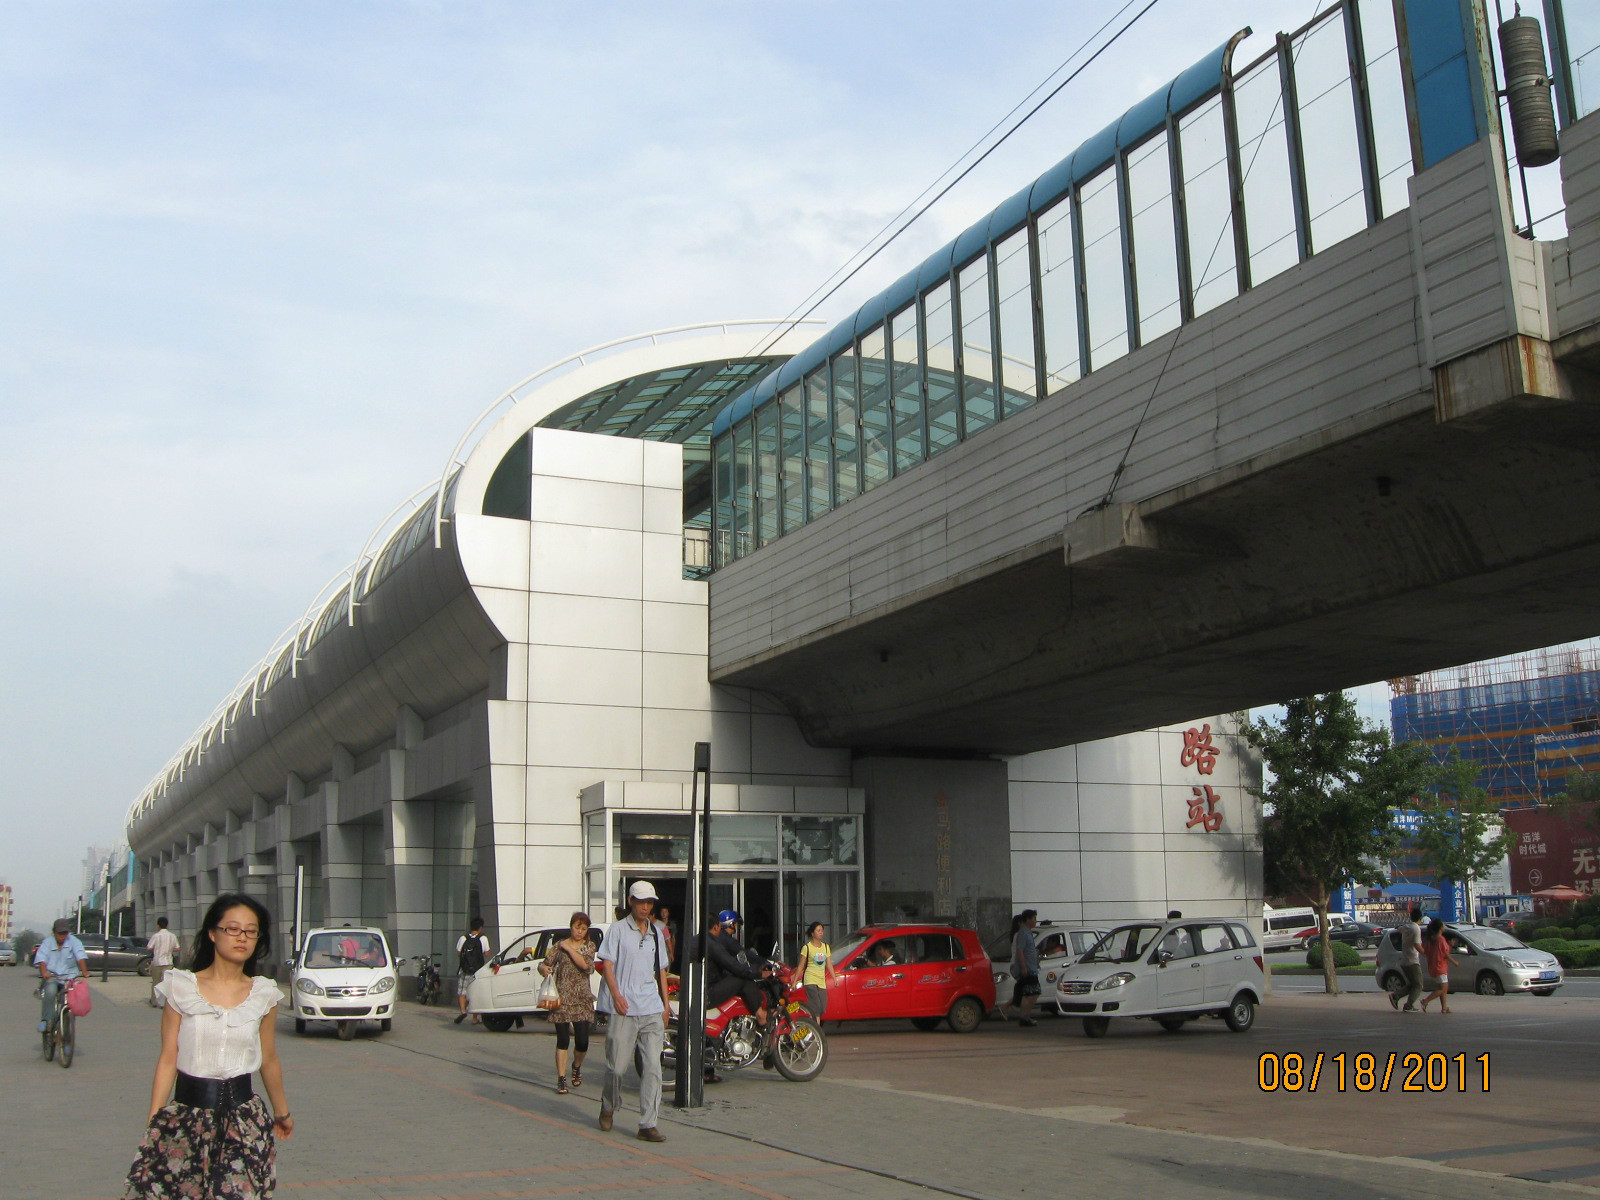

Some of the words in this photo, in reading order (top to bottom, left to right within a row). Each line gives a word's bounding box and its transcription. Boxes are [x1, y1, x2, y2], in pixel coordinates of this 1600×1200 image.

[1181, 723, 1223, 832] 路站
[1522, 831, 1541, 843] 远洋
[1519, 843, 1547, 856] 时代城
